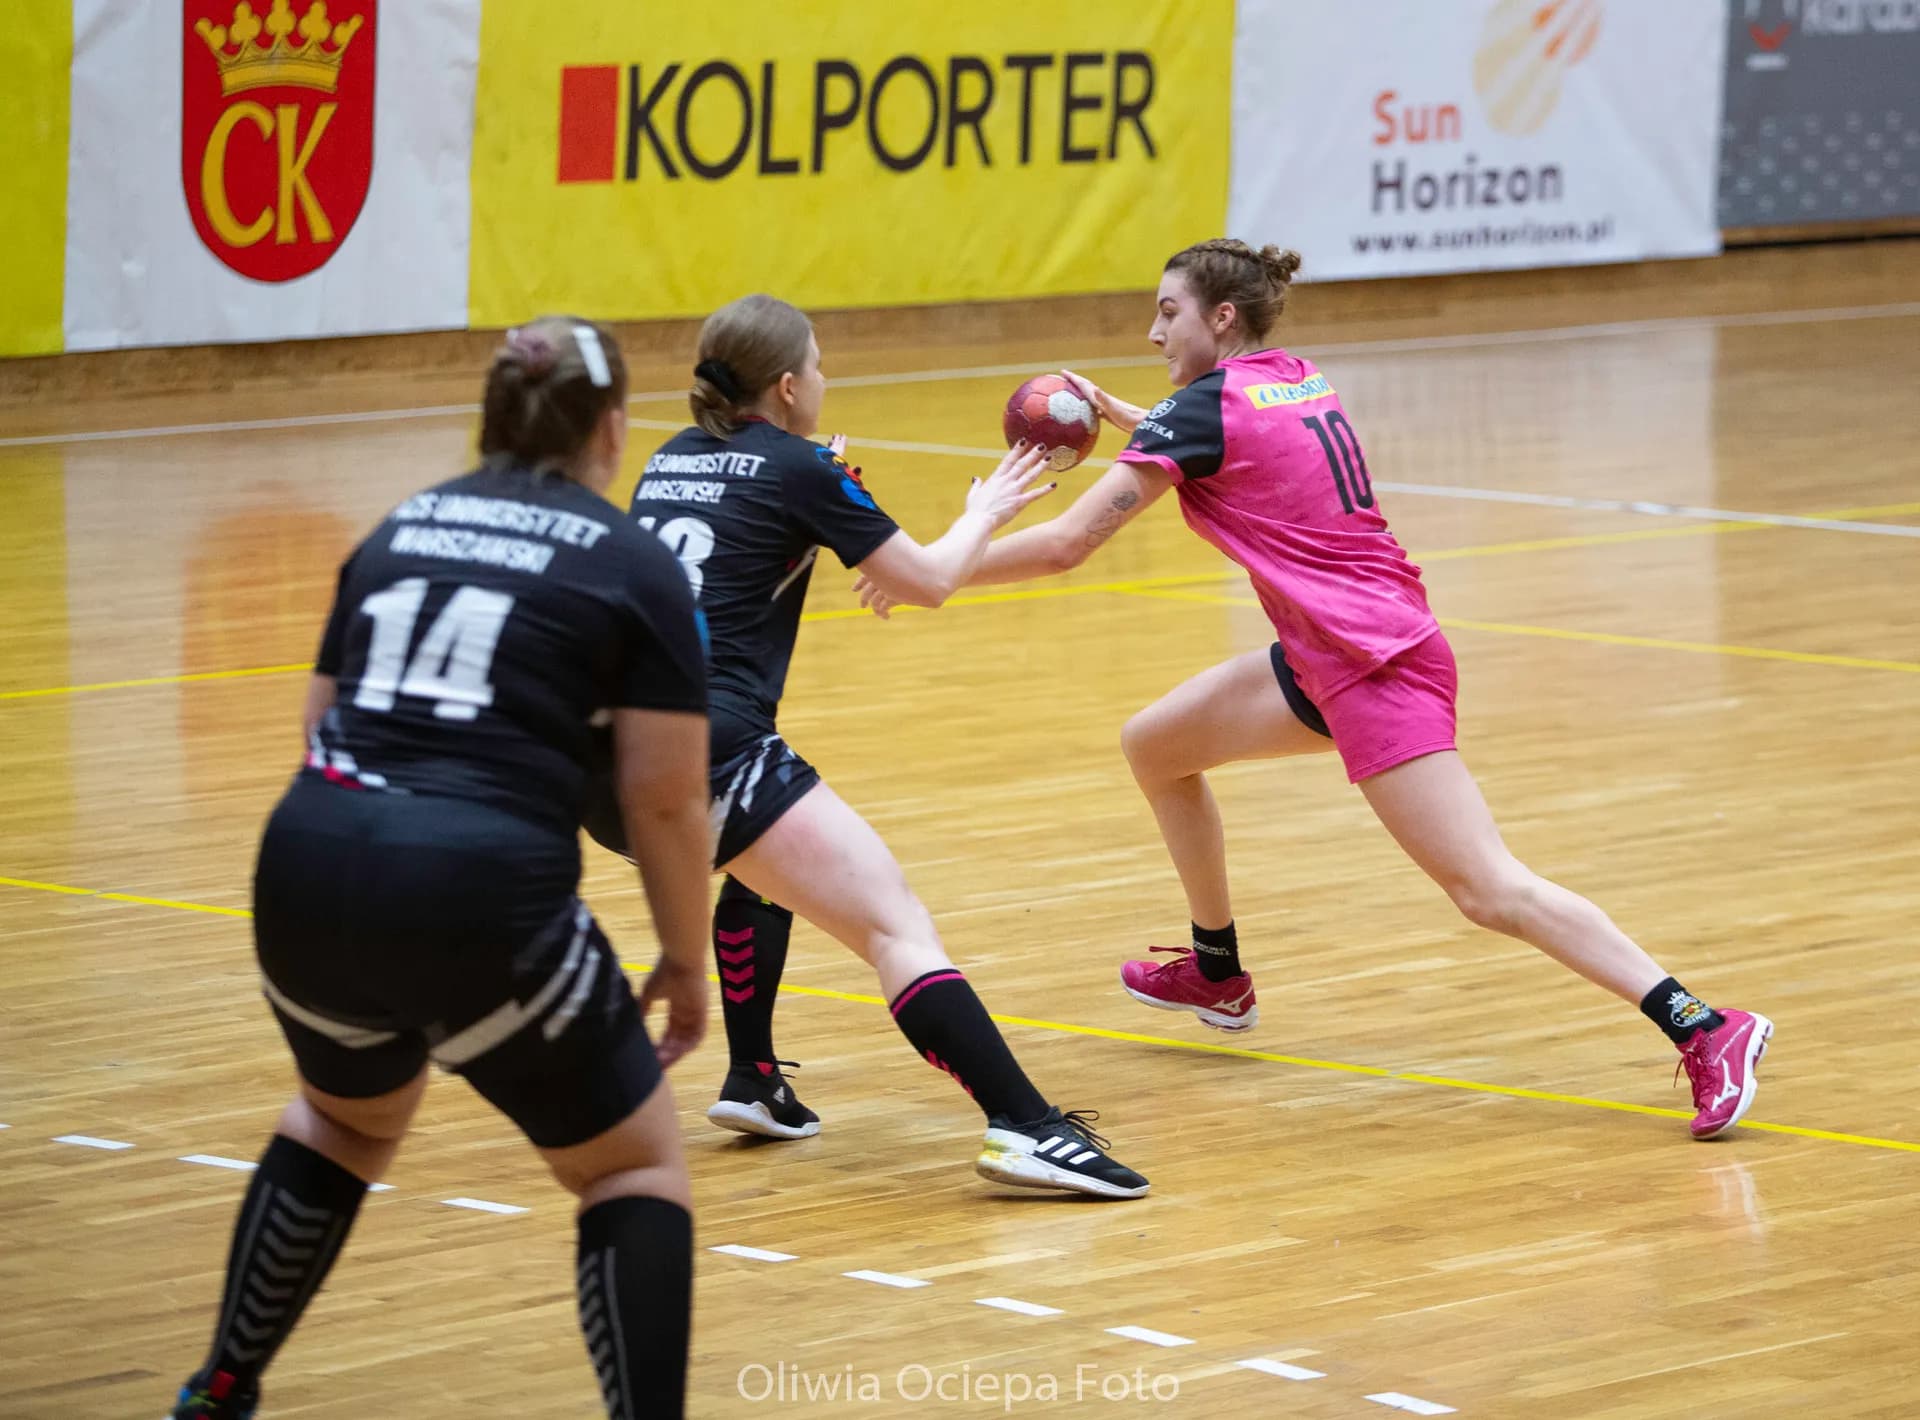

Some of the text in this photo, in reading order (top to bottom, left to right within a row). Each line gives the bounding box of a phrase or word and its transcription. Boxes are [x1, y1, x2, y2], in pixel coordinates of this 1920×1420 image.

[201, 101, 338, 248] CK
[624, 52, 1156, 181] KOLPORTER
[1372, 90, 1462, 146] Sun
[1370, 153, 1564, 213] Horizon
[1302, 410, 1374, 514] 10
[352, 577, 515, 720] 14
